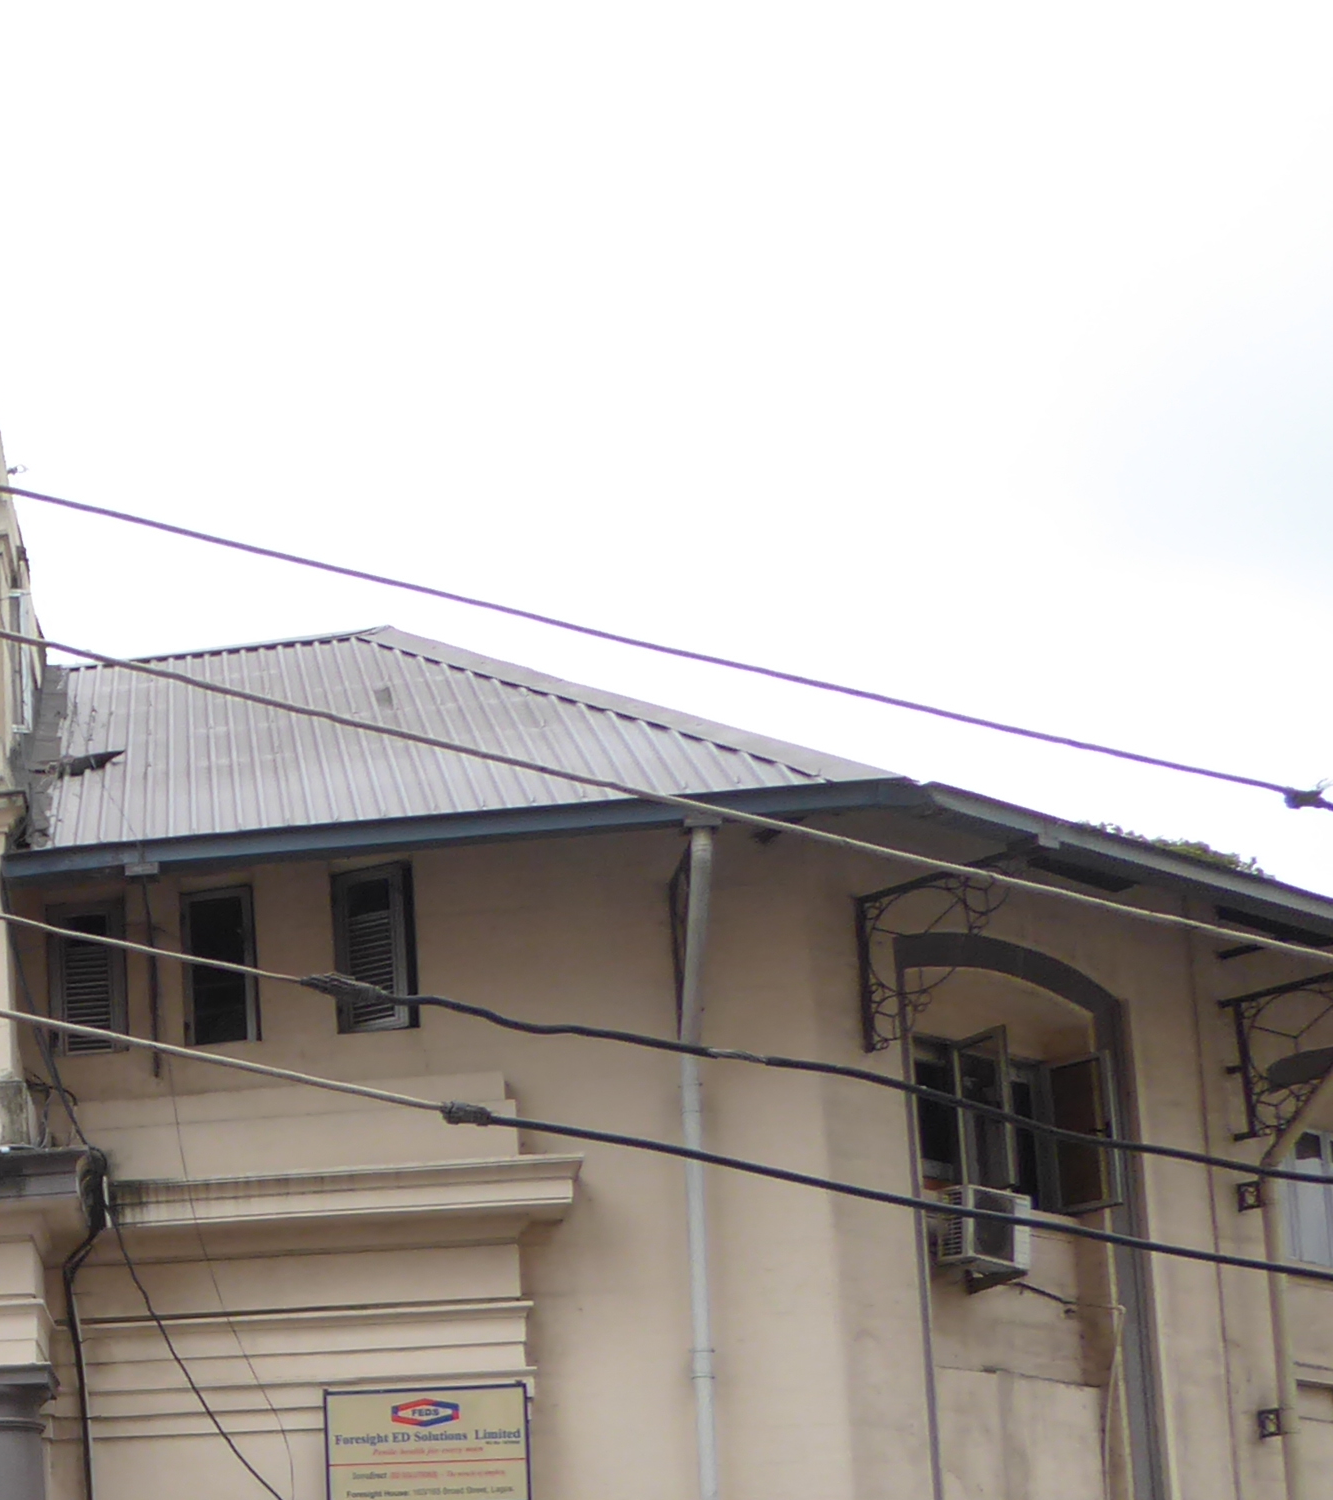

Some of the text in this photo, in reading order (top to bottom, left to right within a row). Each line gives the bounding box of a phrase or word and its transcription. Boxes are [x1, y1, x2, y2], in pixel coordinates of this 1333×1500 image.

[411, 1408, 440, 1417] FEDS
[335, 1428, 521, 1447] Foresight ED Solutions Limited
[347, 1490, 383, 1499] Foresight
